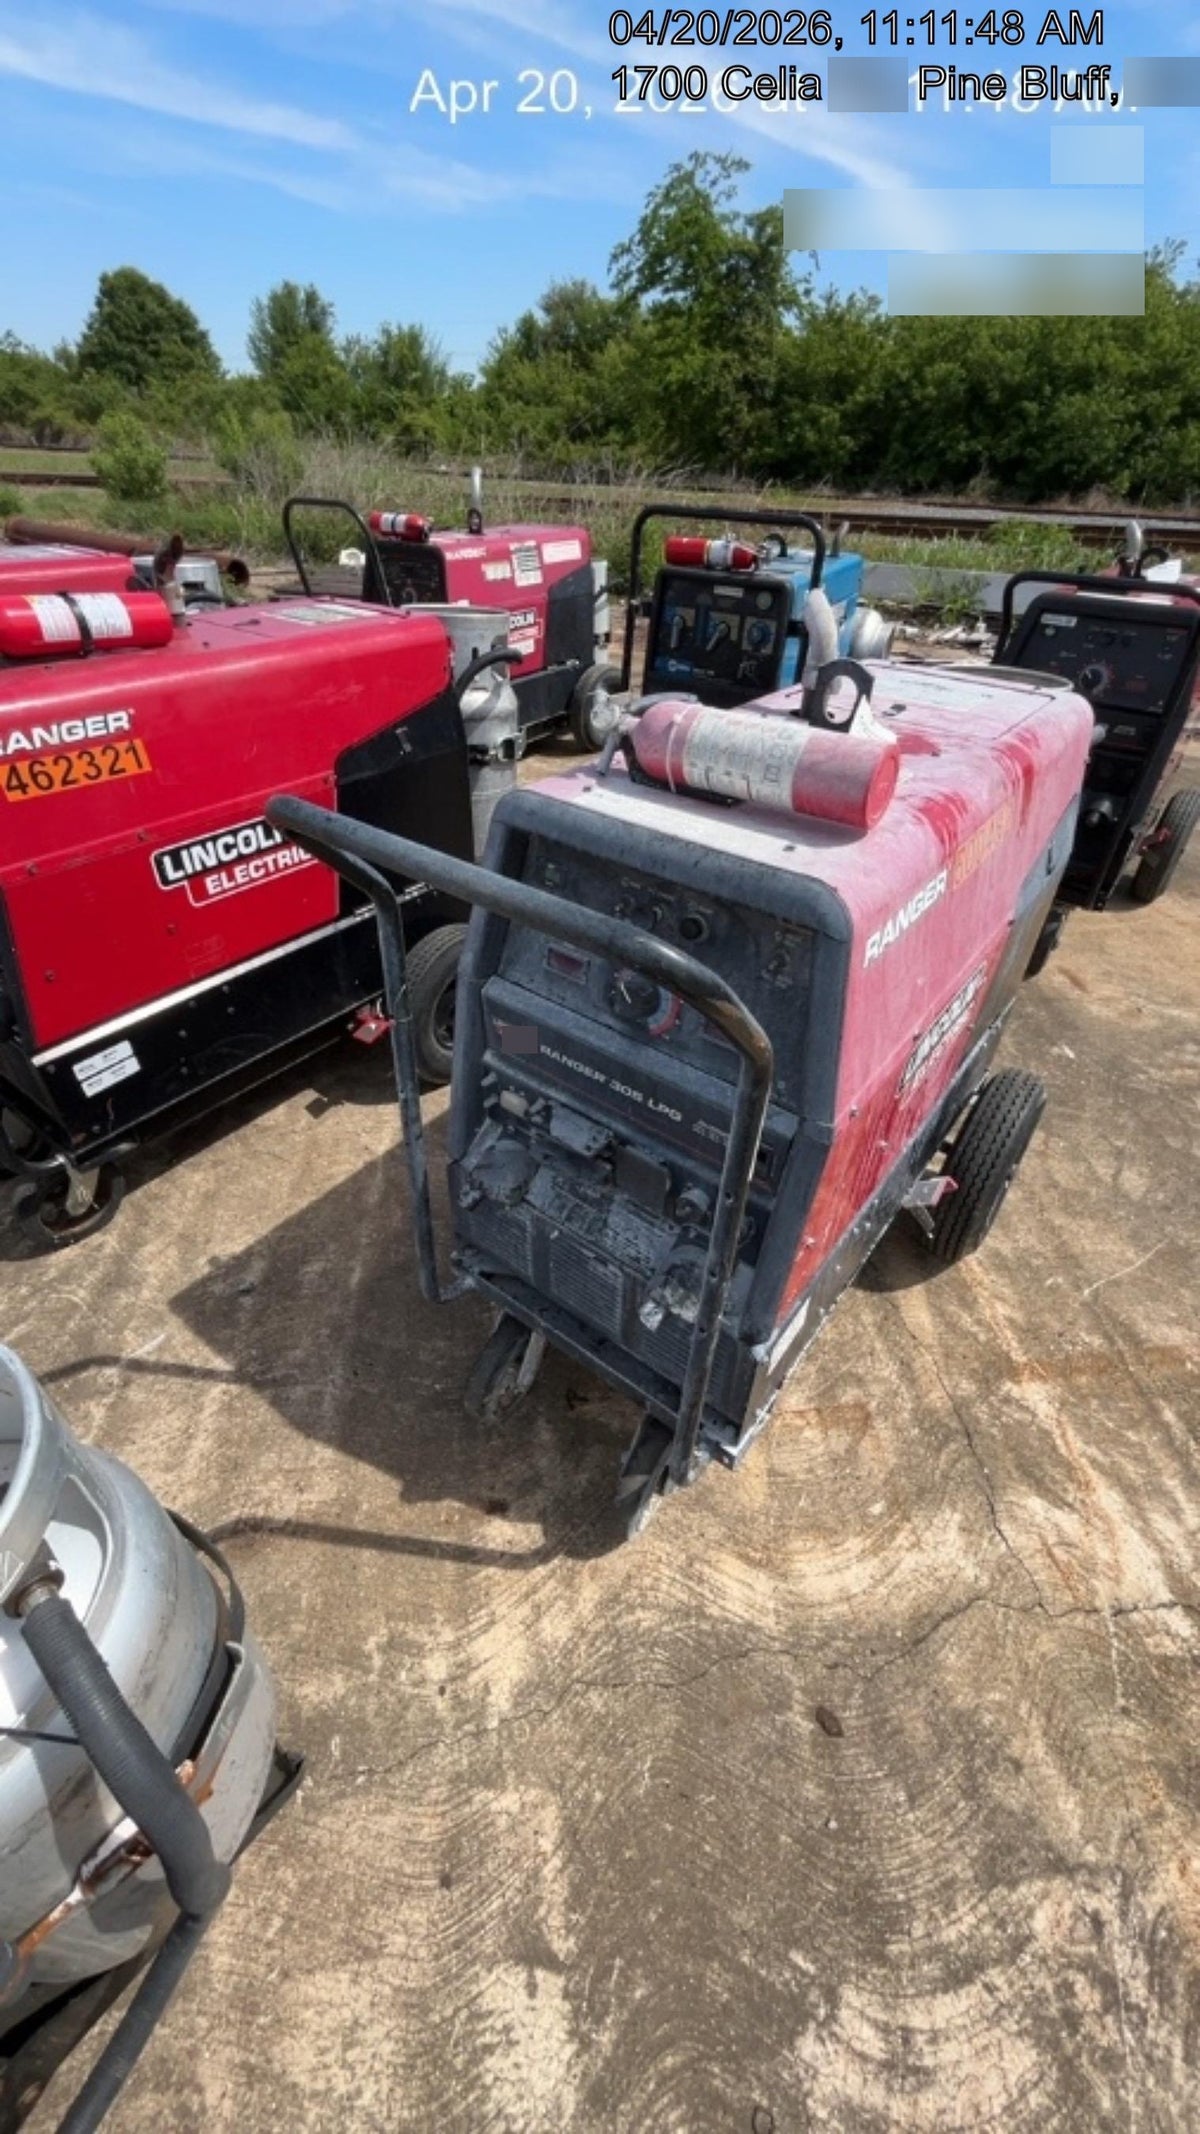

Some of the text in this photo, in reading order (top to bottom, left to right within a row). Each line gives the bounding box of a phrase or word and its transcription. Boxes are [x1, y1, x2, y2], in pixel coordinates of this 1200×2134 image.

[5, 740, 144, 796] 462321
[863, 868, 947, 969] RANGER
[540, 1045, 606, 1084] RANGER
